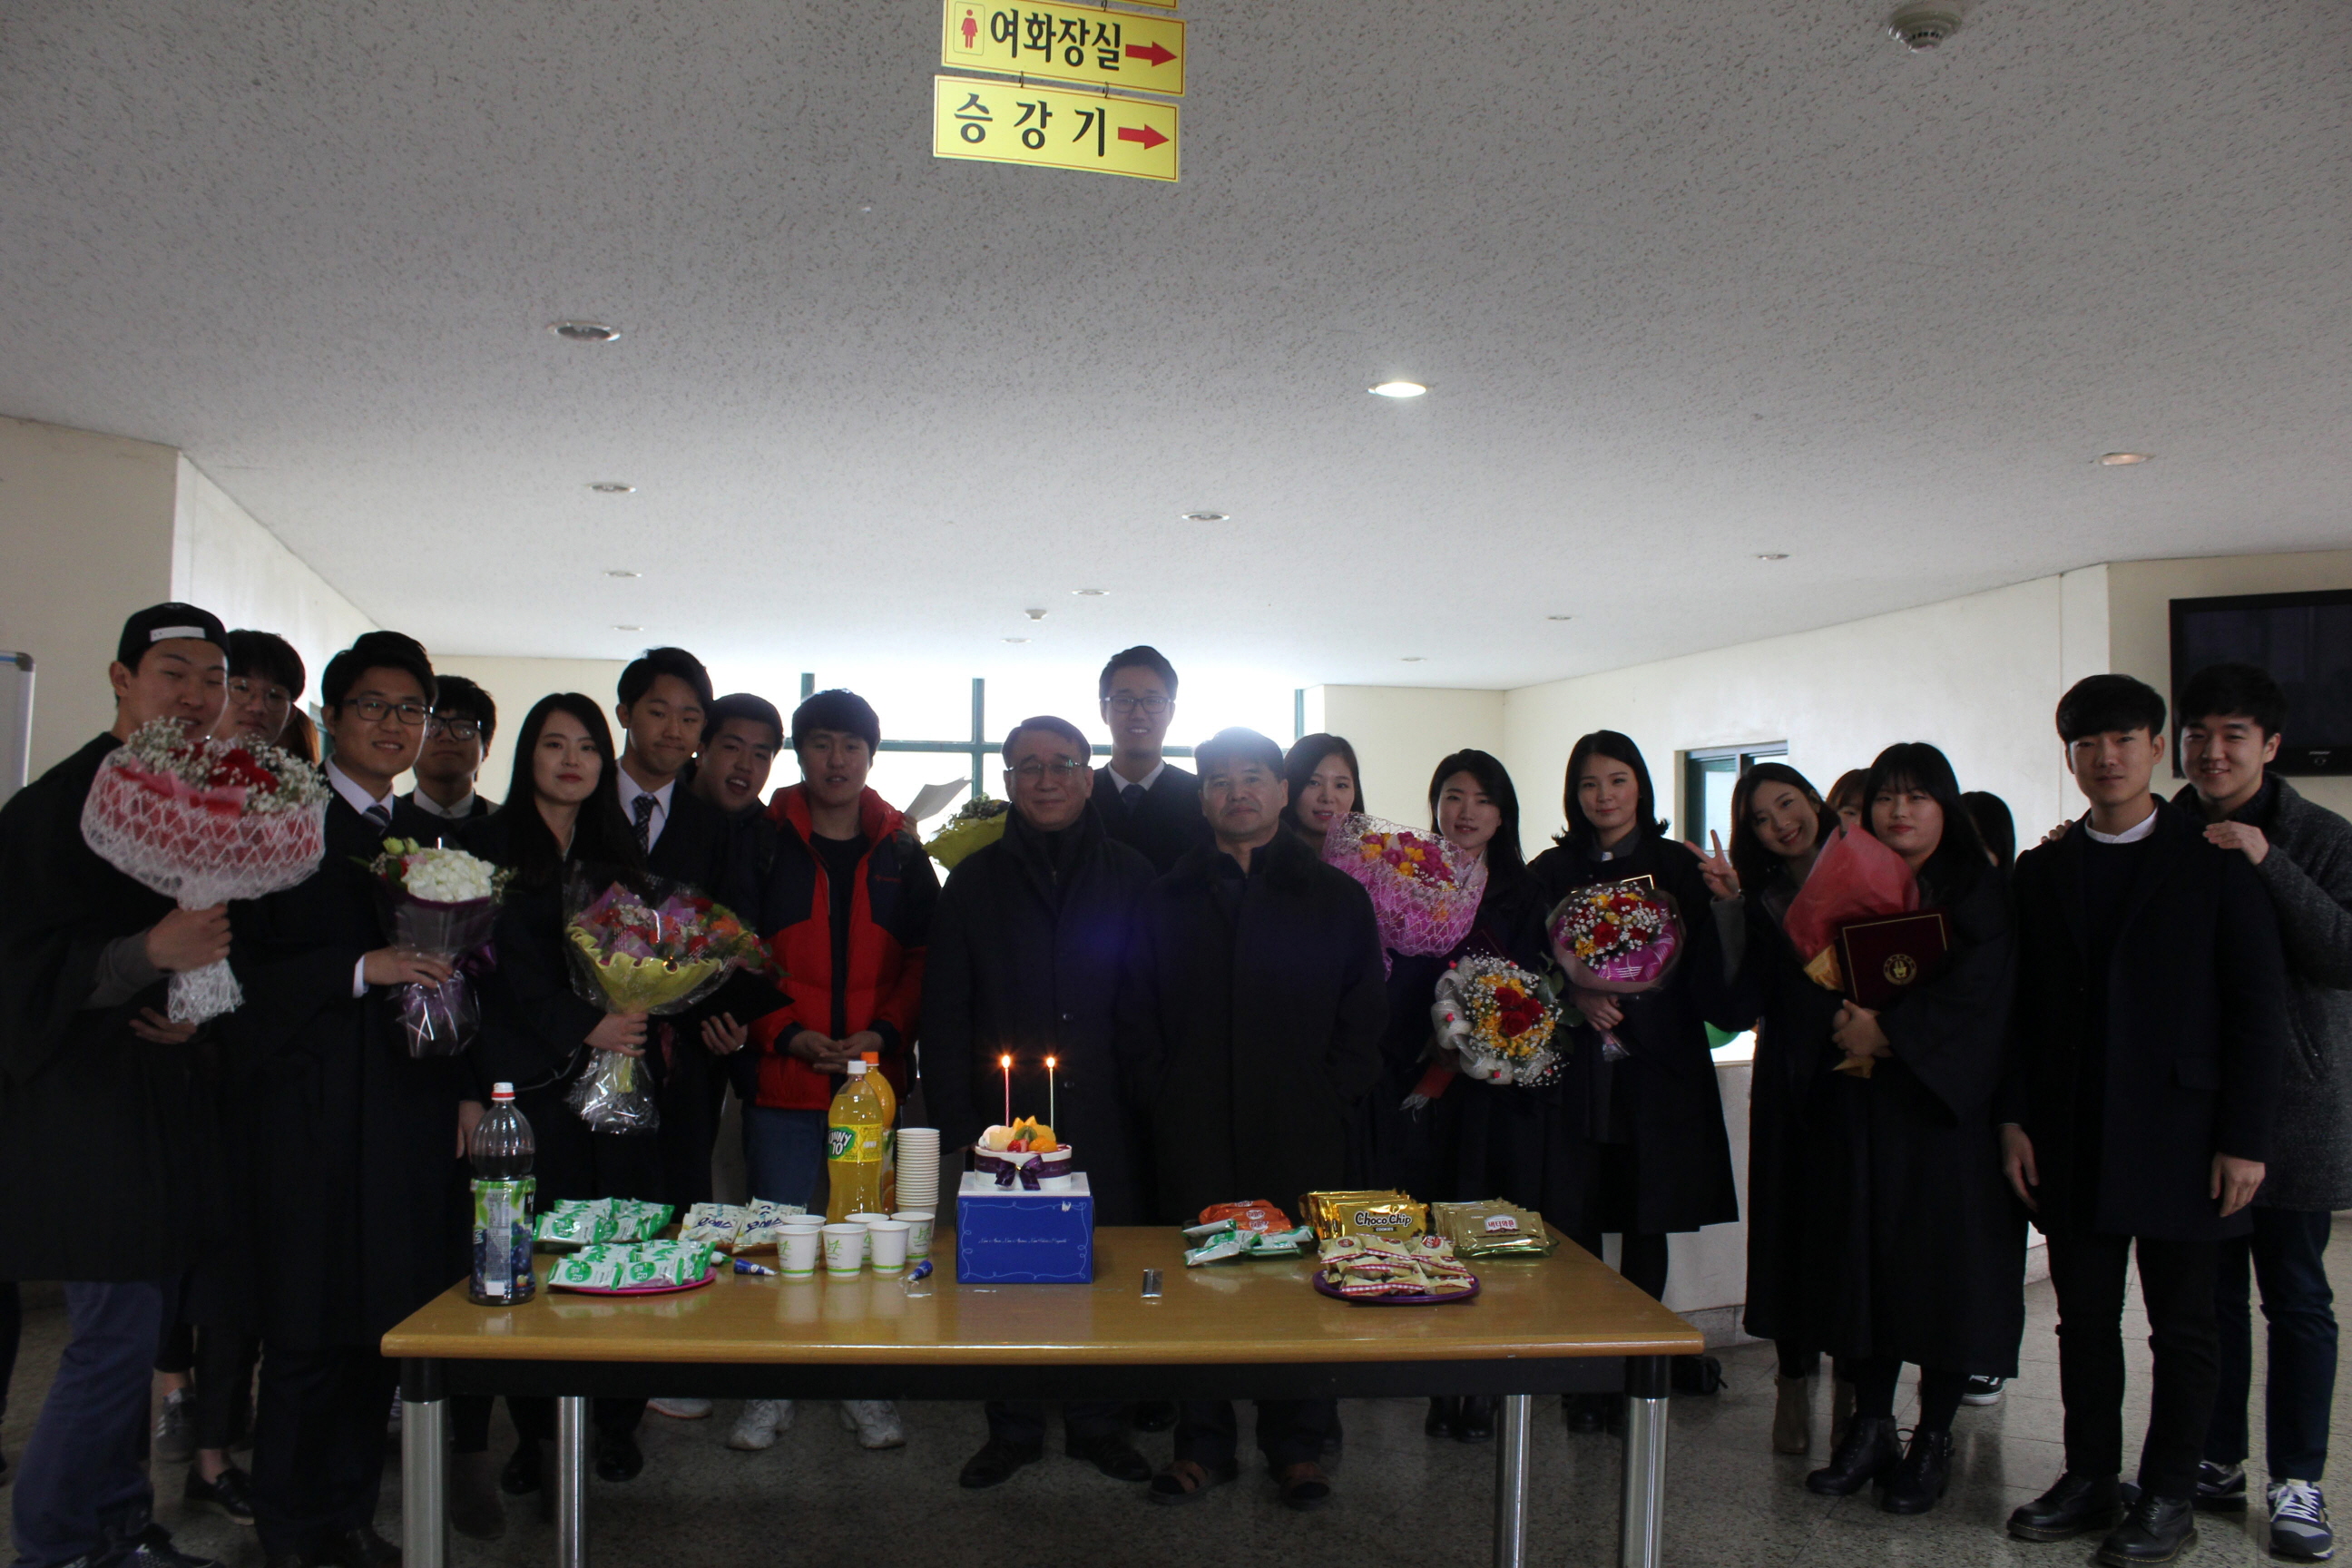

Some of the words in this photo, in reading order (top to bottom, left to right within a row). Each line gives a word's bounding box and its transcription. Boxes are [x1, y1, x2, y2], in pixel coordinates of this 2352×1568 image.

[990, 8, 1122, 72] 여화장실
[954, 93, 1105, 157] 승강기
[828, 1130, 852, 1147] UNNY
[832, 1142, 844, 1156] 10
[1355, 1210, 1387, 1227] Choco
[1388, 1213, 1413, 1228] Chip
[1487, 1220, 1514, 1229] 버터와플
